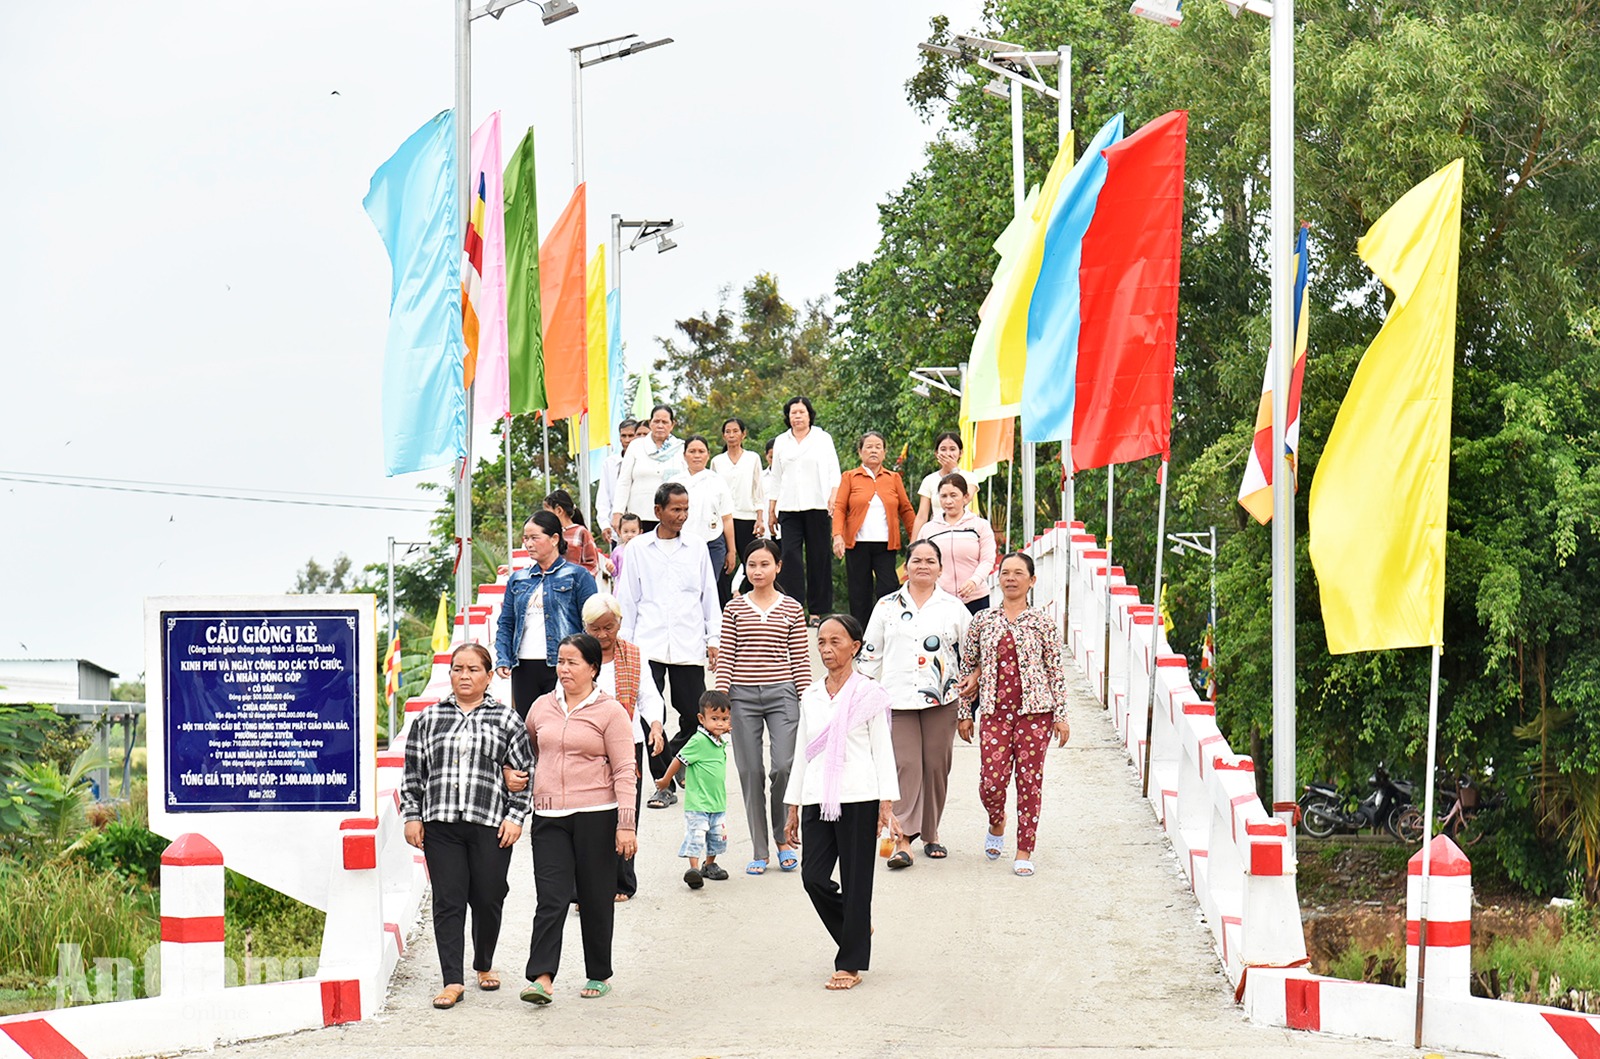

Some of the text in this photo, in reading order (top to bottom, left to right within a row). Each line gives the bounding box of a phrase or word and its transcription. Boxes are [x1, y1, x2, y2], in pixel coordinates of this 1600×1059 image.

[206, 620, 317, 644] CẦU GIỒNG KÈ
[188, 645, 206, 655] (Công
[238, 645, 254, 655] thông
[256, 645, 270, 654] nông
[296, 645, 313, 654] Giang
[315, 644, 335, 653] Thành)
[181, 657, 344, 671] KINH PHÍ VÀ NGÀY CÔNG DO CÁC TỔ CHỨC,
[224, 671, 301, 682] CÁ NHÂN ĐÓNG GÓP
[181, 769, 347, 787] TỔNG GIÁ TRỊ ĐÓNG GÓP: 1.900.000.000 ĐỒNG
